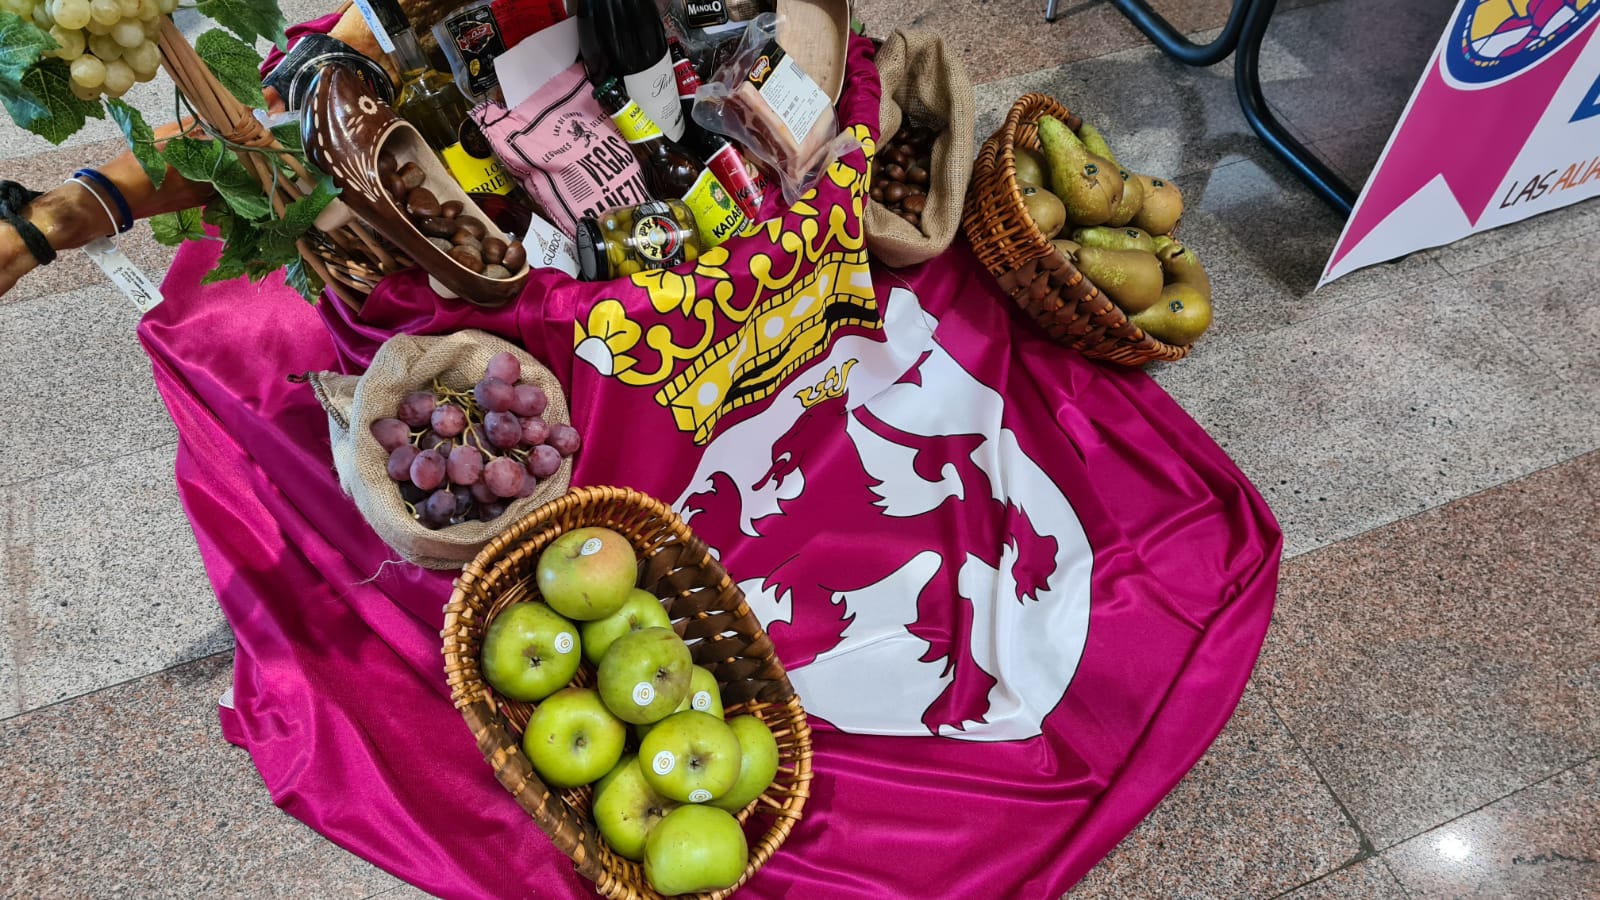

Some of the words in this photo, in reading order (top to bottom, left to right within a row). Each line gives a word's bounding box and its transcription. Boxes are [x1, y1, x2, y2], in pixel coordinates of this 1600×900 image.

[688, 1, 722, 16] MANOLO
[576, 135, 634, 188] VEGAS
[1499, 169, 1558, 209] LAS
